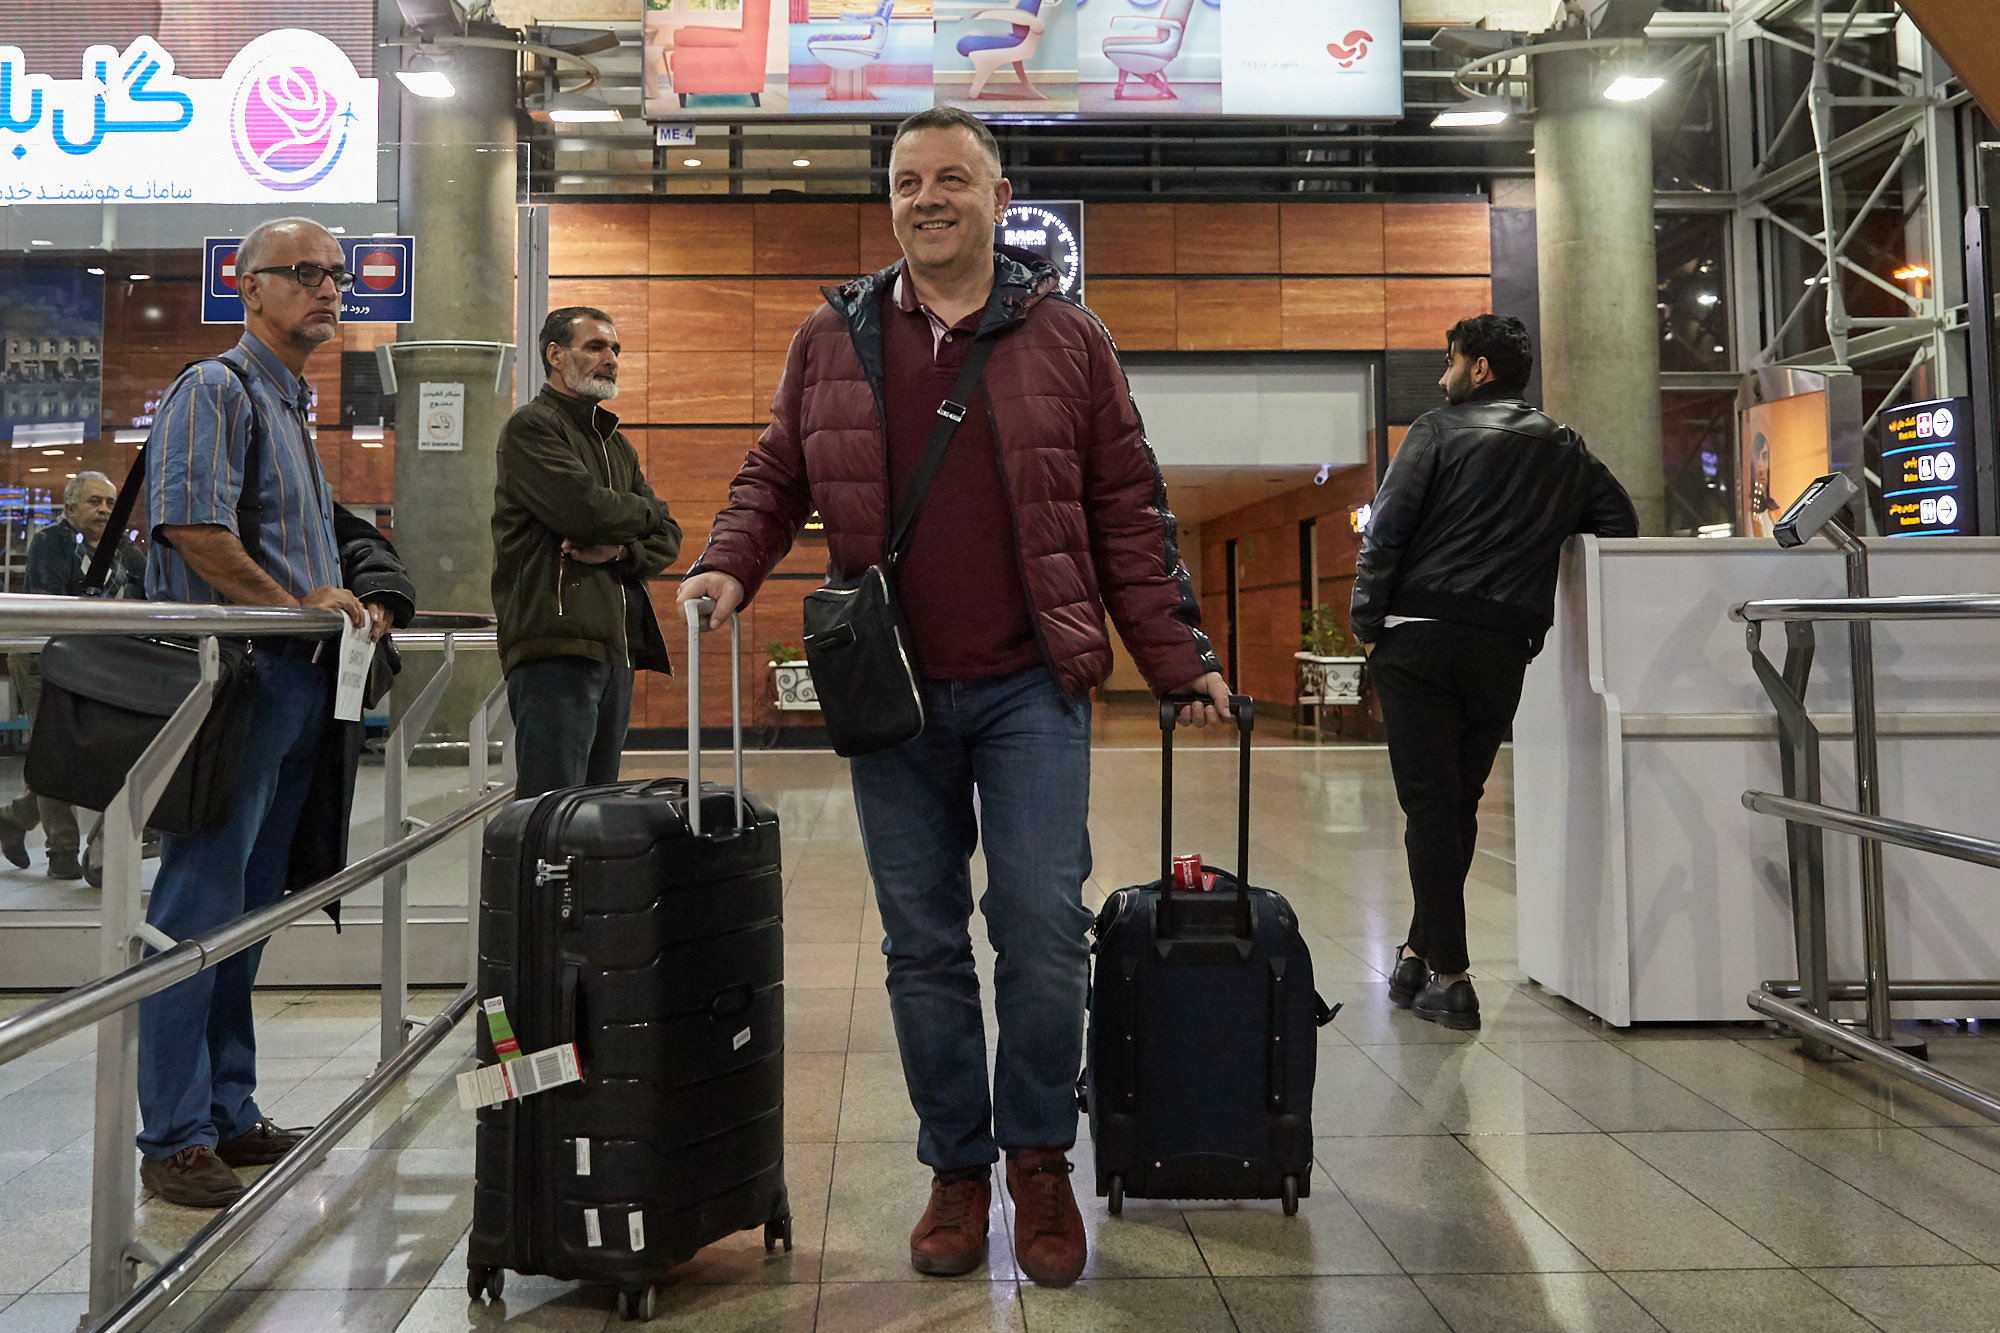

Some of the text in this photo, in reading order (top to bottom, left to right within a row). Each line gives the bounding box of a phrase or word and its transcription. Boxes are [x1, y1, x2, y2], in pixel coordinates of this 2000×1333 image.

[0, 50, 194, 160] گل بل
[660, 128, 694, 140] ME-4
[36, 180, 120, 204] هوشمند
[124, 180, 193, 200] سامانه
[349, 305, 370, 315] ورود
